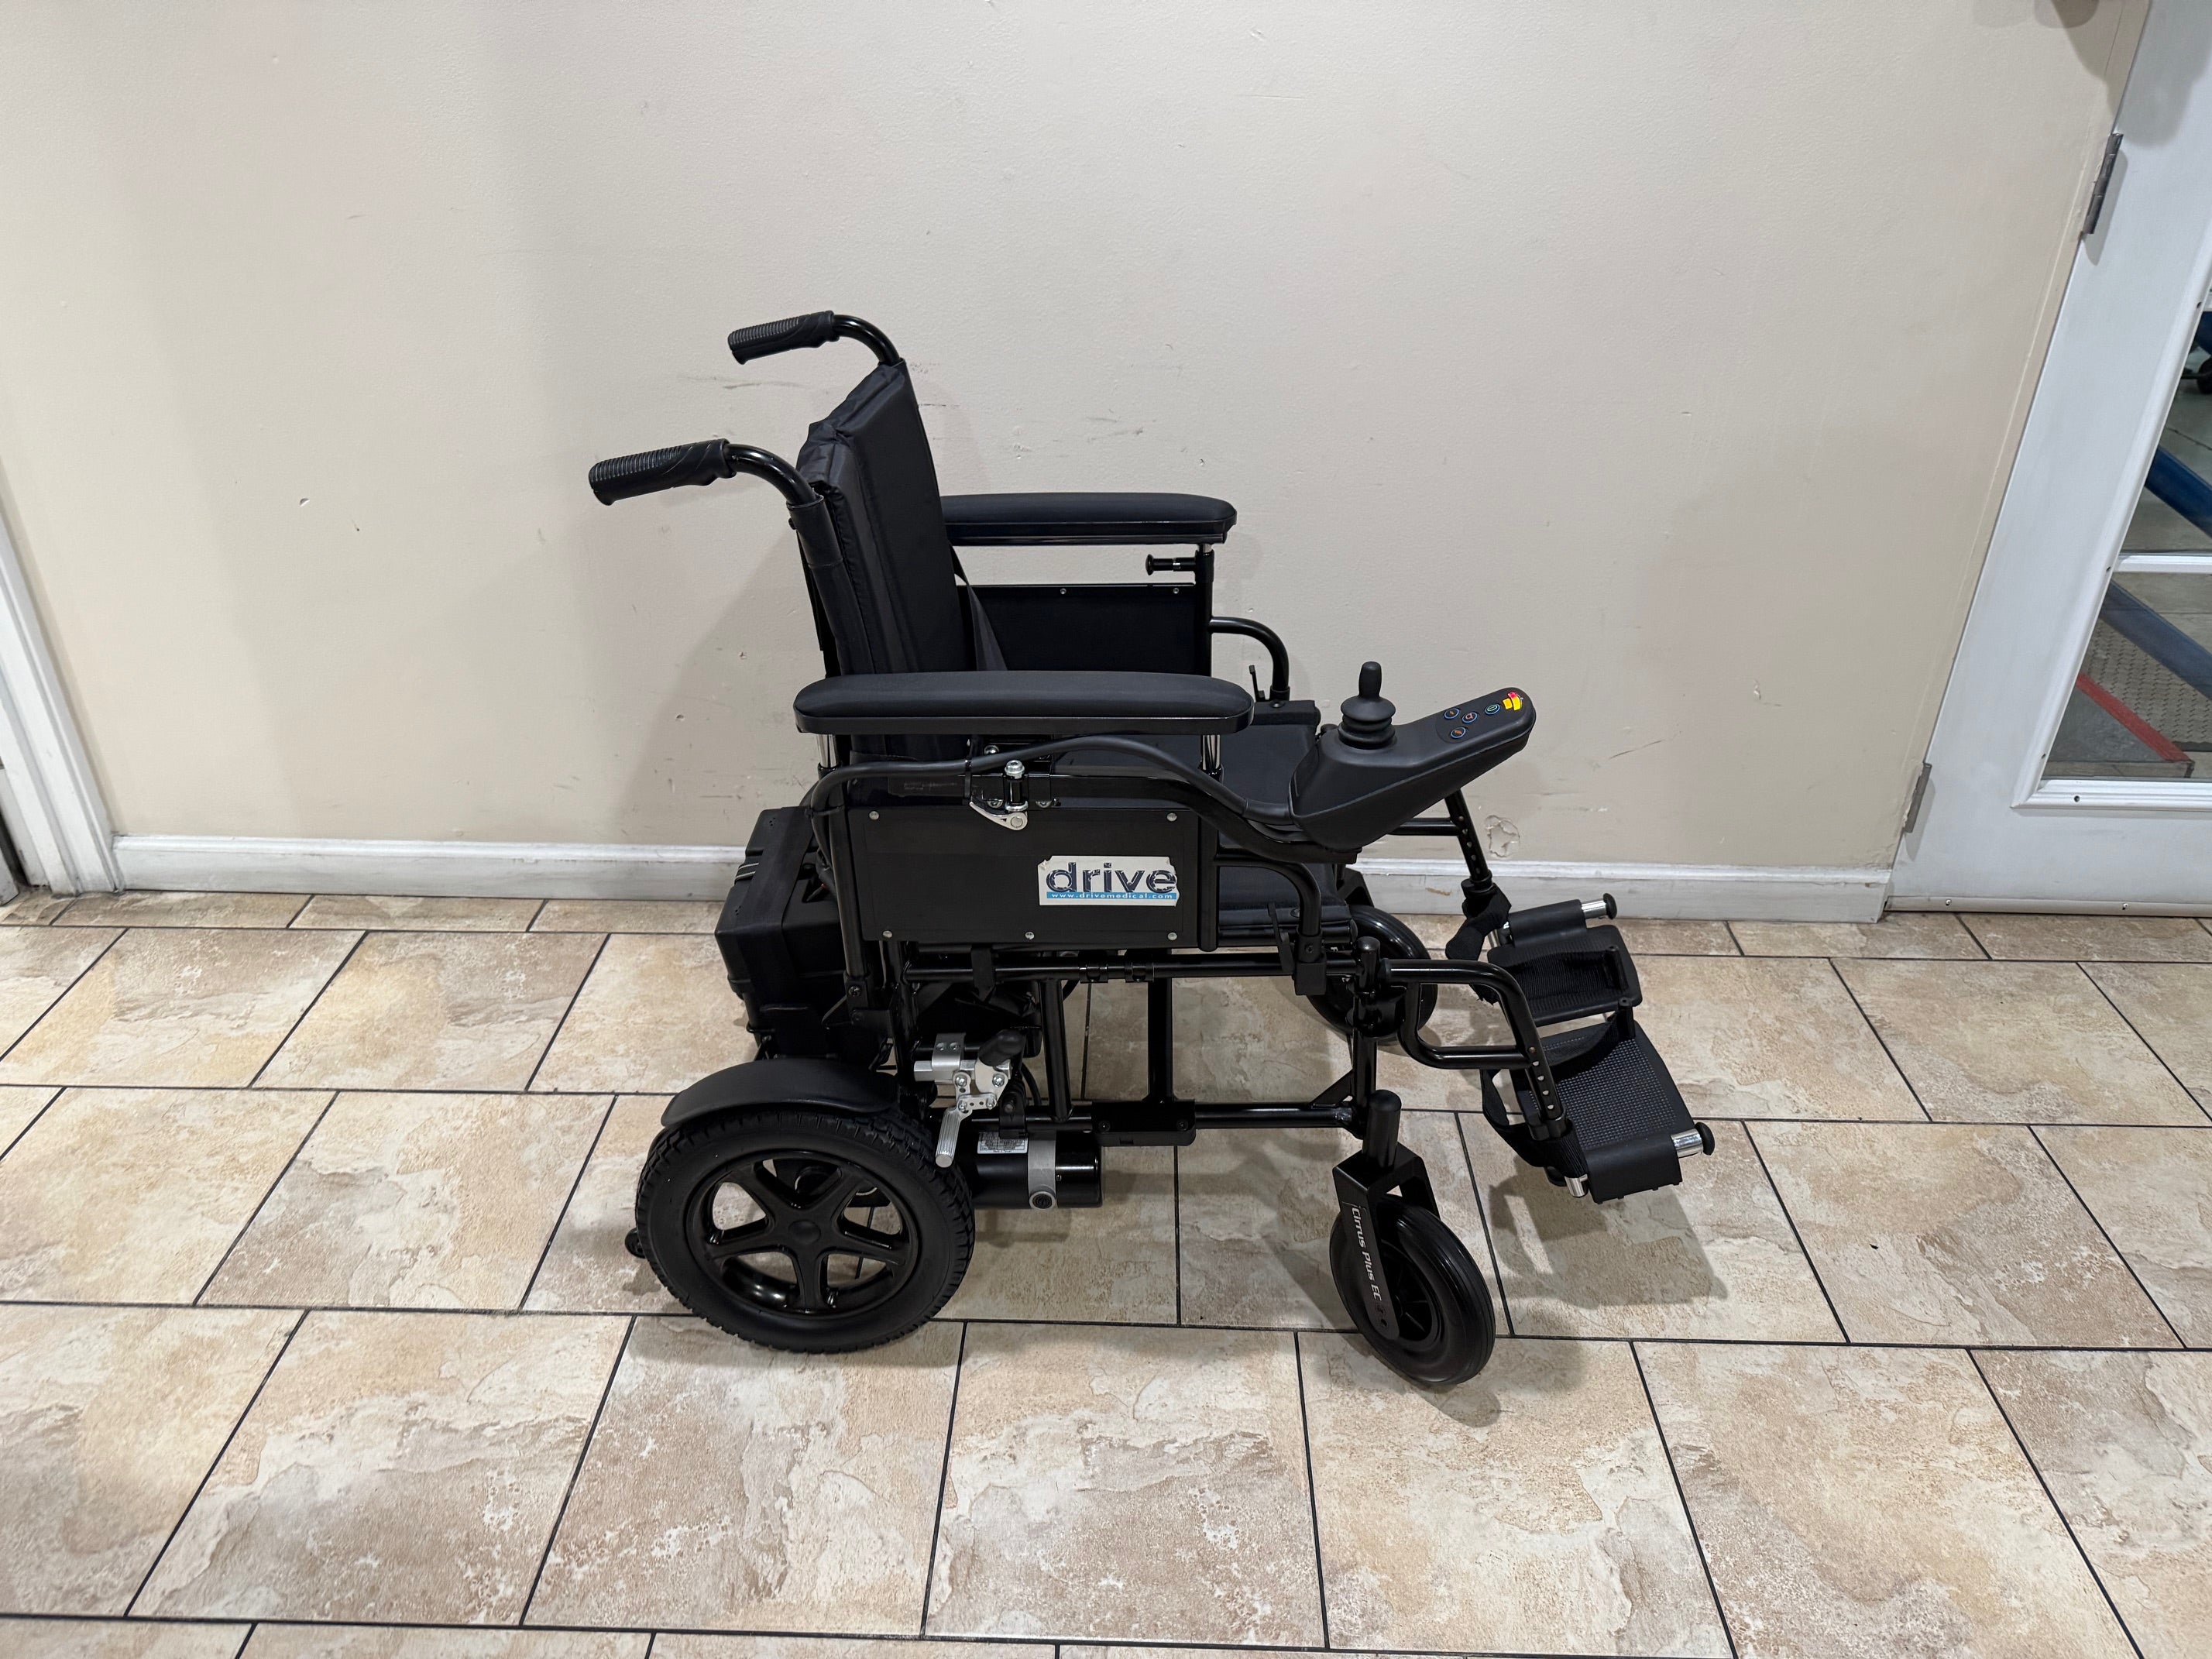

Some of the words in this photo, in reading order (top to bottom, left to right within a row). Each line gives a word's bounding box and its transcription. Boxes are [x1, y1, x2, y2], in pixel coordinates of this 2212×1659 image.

[1046, 862, 1176, 894] drive
[1352, 1207, 1366, 1249] Cirrus
[1362, 1251, 1375, 1282] Plus
[1371, 1283, 1382, 1301] EC
